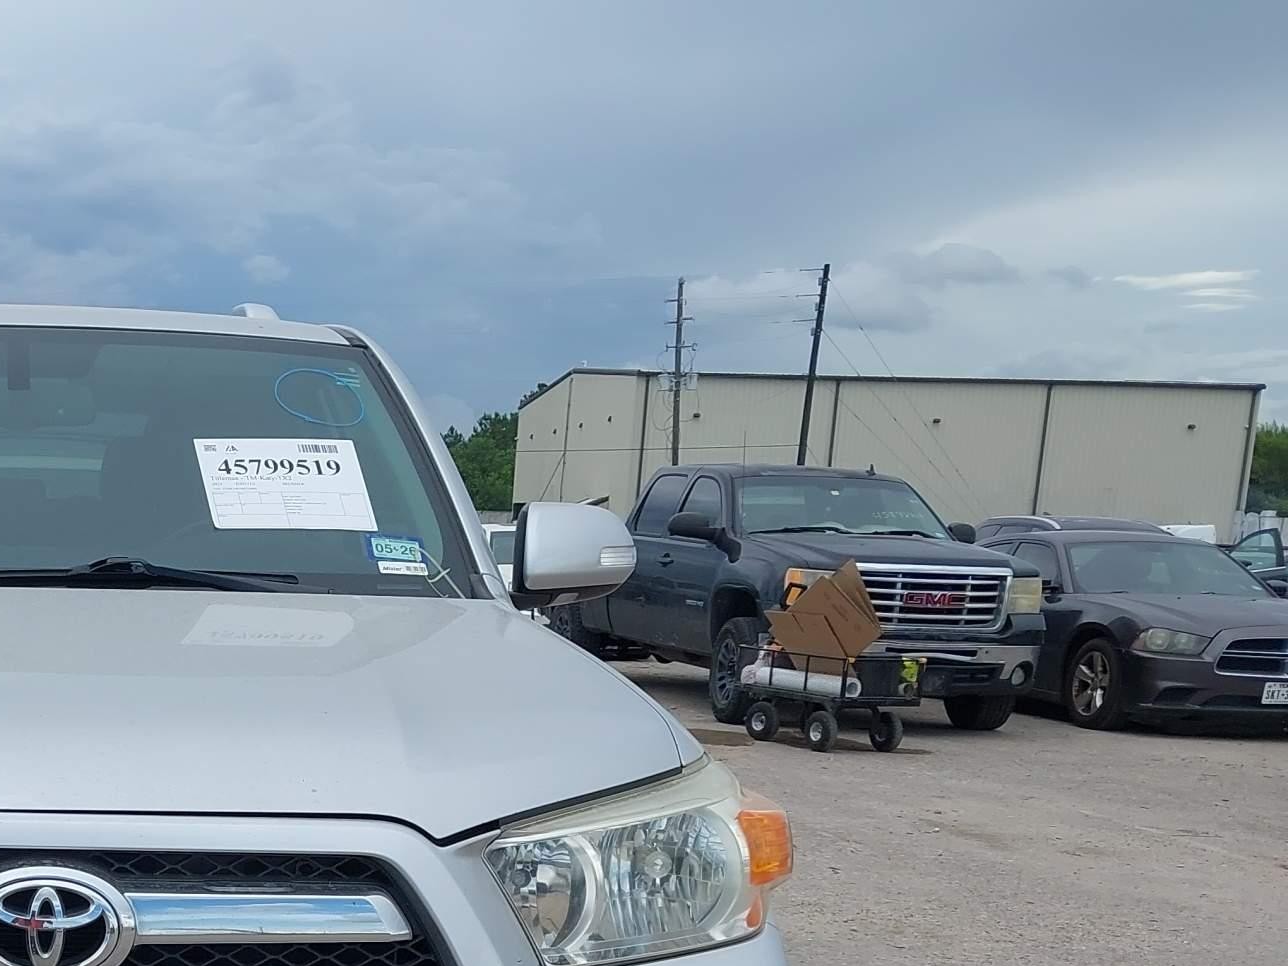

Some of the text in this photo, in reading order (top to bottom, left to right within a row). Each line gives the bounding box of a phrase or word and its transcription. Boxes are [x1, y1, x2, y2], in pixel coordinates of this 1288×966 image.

[217, 458, 341, 476] 45799519
[375, 543, 393, 554] 05
[902, 590, 967, 609] GMC
